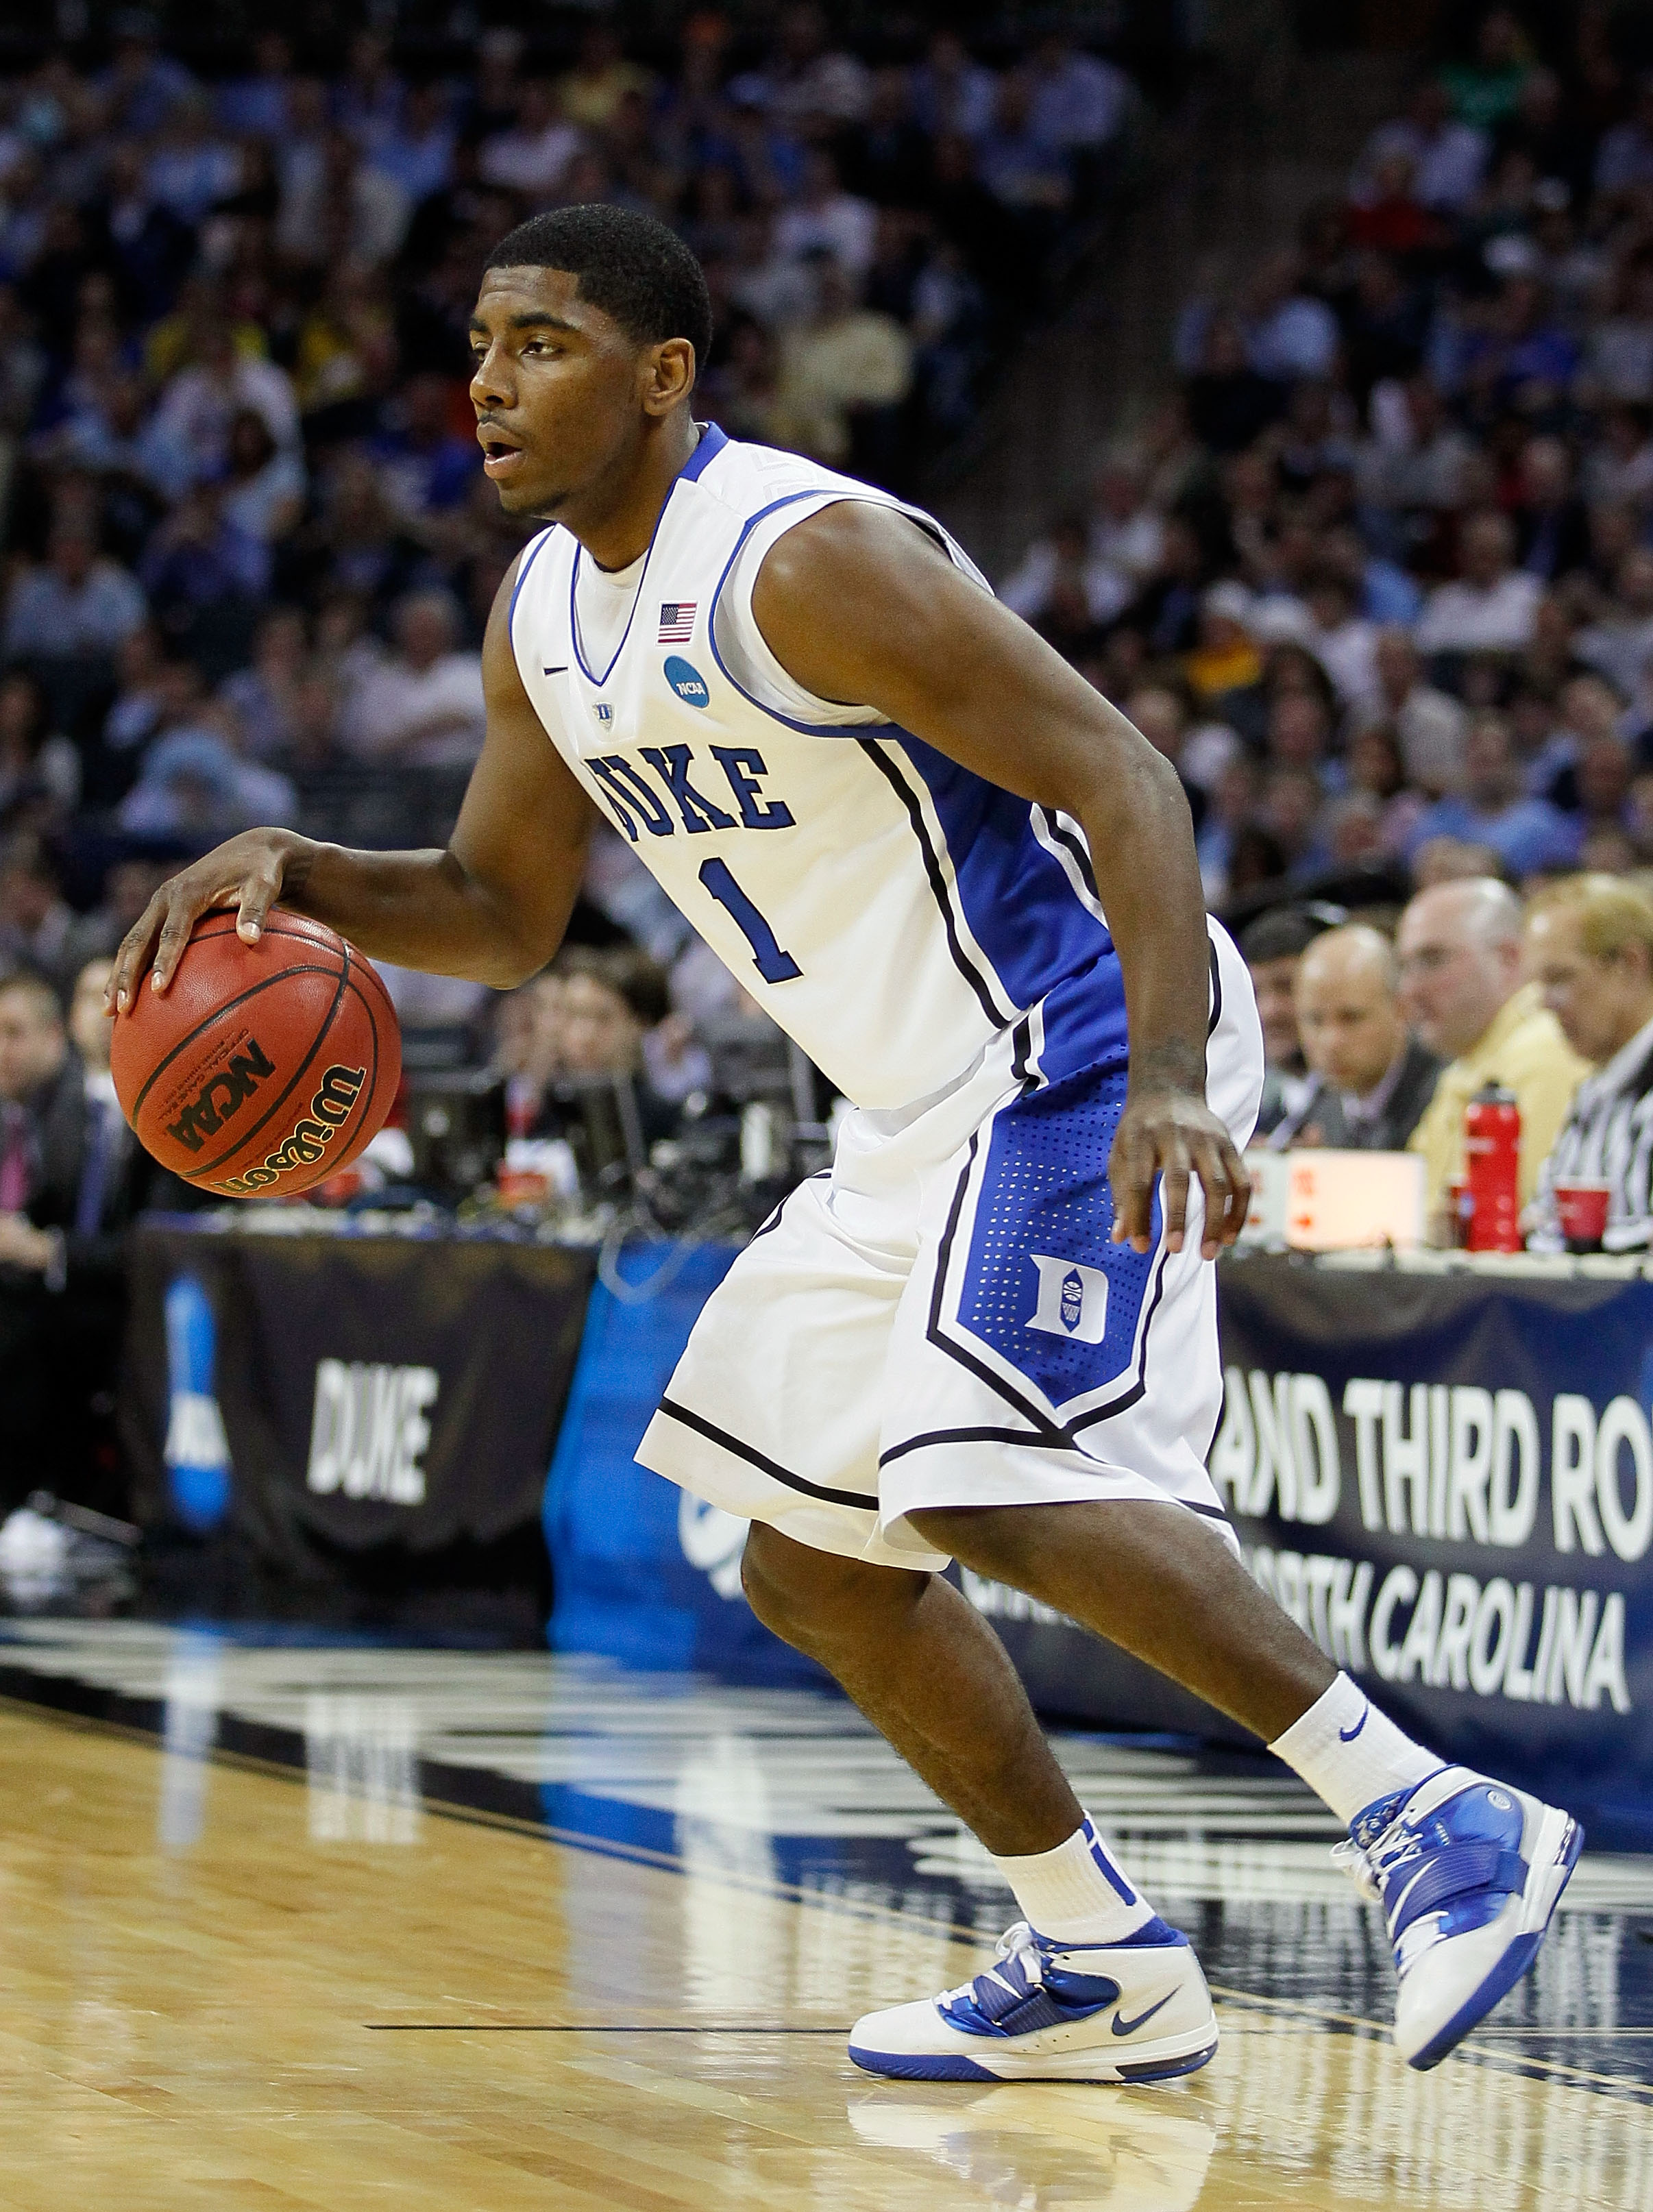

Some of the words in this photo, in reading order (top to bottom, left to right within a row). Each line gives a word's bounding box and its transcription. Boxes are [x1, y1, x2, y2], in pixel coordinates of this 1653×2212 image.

[676, 682, 706, 696] NCAA
[583, 743, 798, 842] UKE
[698, 857, 805, 984] 1
[166, 1037, 276, 1153] NCAA
[210, 1064, 367, 1194] Wilson
[1208, 1366, 1341, 1525] AND
[1342, 1377, 1541, 1549] THIRD
[1550, 1392, 1653, 1563] RO
[1242, 1545, 1374, 1673] RTH
[1369, 1564, 1632, 1715] CAROLINA
